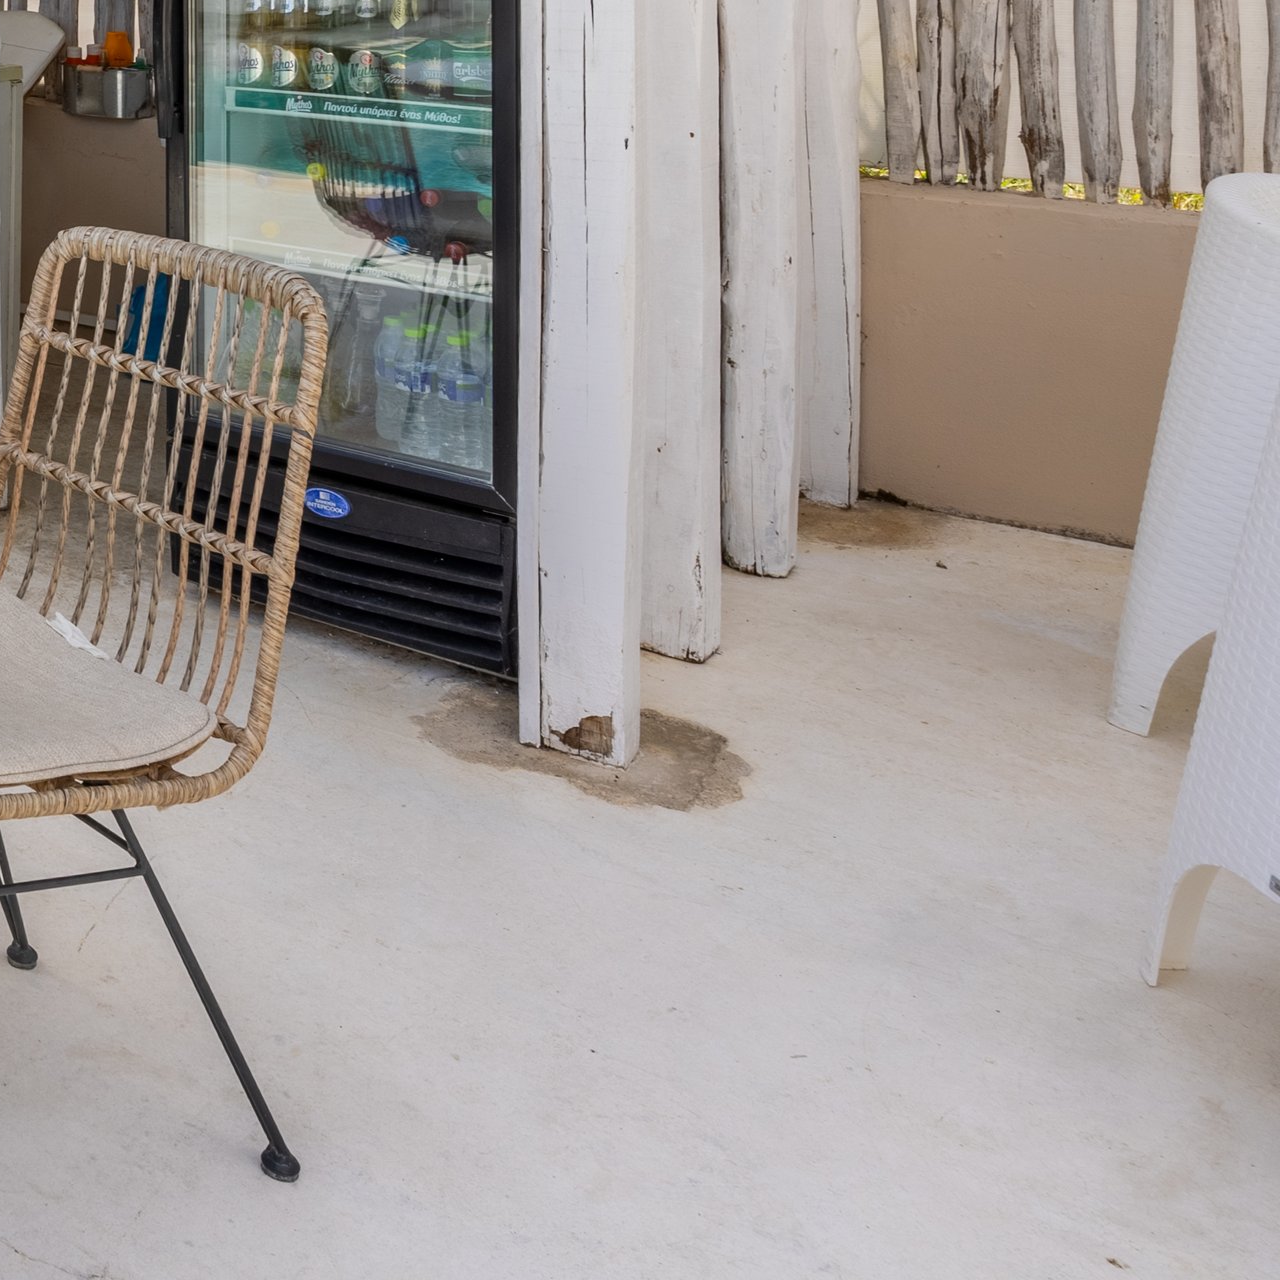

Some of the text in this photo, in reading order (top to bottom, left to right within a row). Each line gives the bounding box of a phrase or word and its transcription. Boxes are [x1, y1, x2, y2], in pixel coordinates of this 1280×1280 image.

[453, 62, 490, 80] Carlsbe
[285, 97, 313, 113] Mythos
[323, 101, 462, 125] Παντού υπάρχει ένας Μύθος!
[307, 501, 345, 515] INTERCOOL
